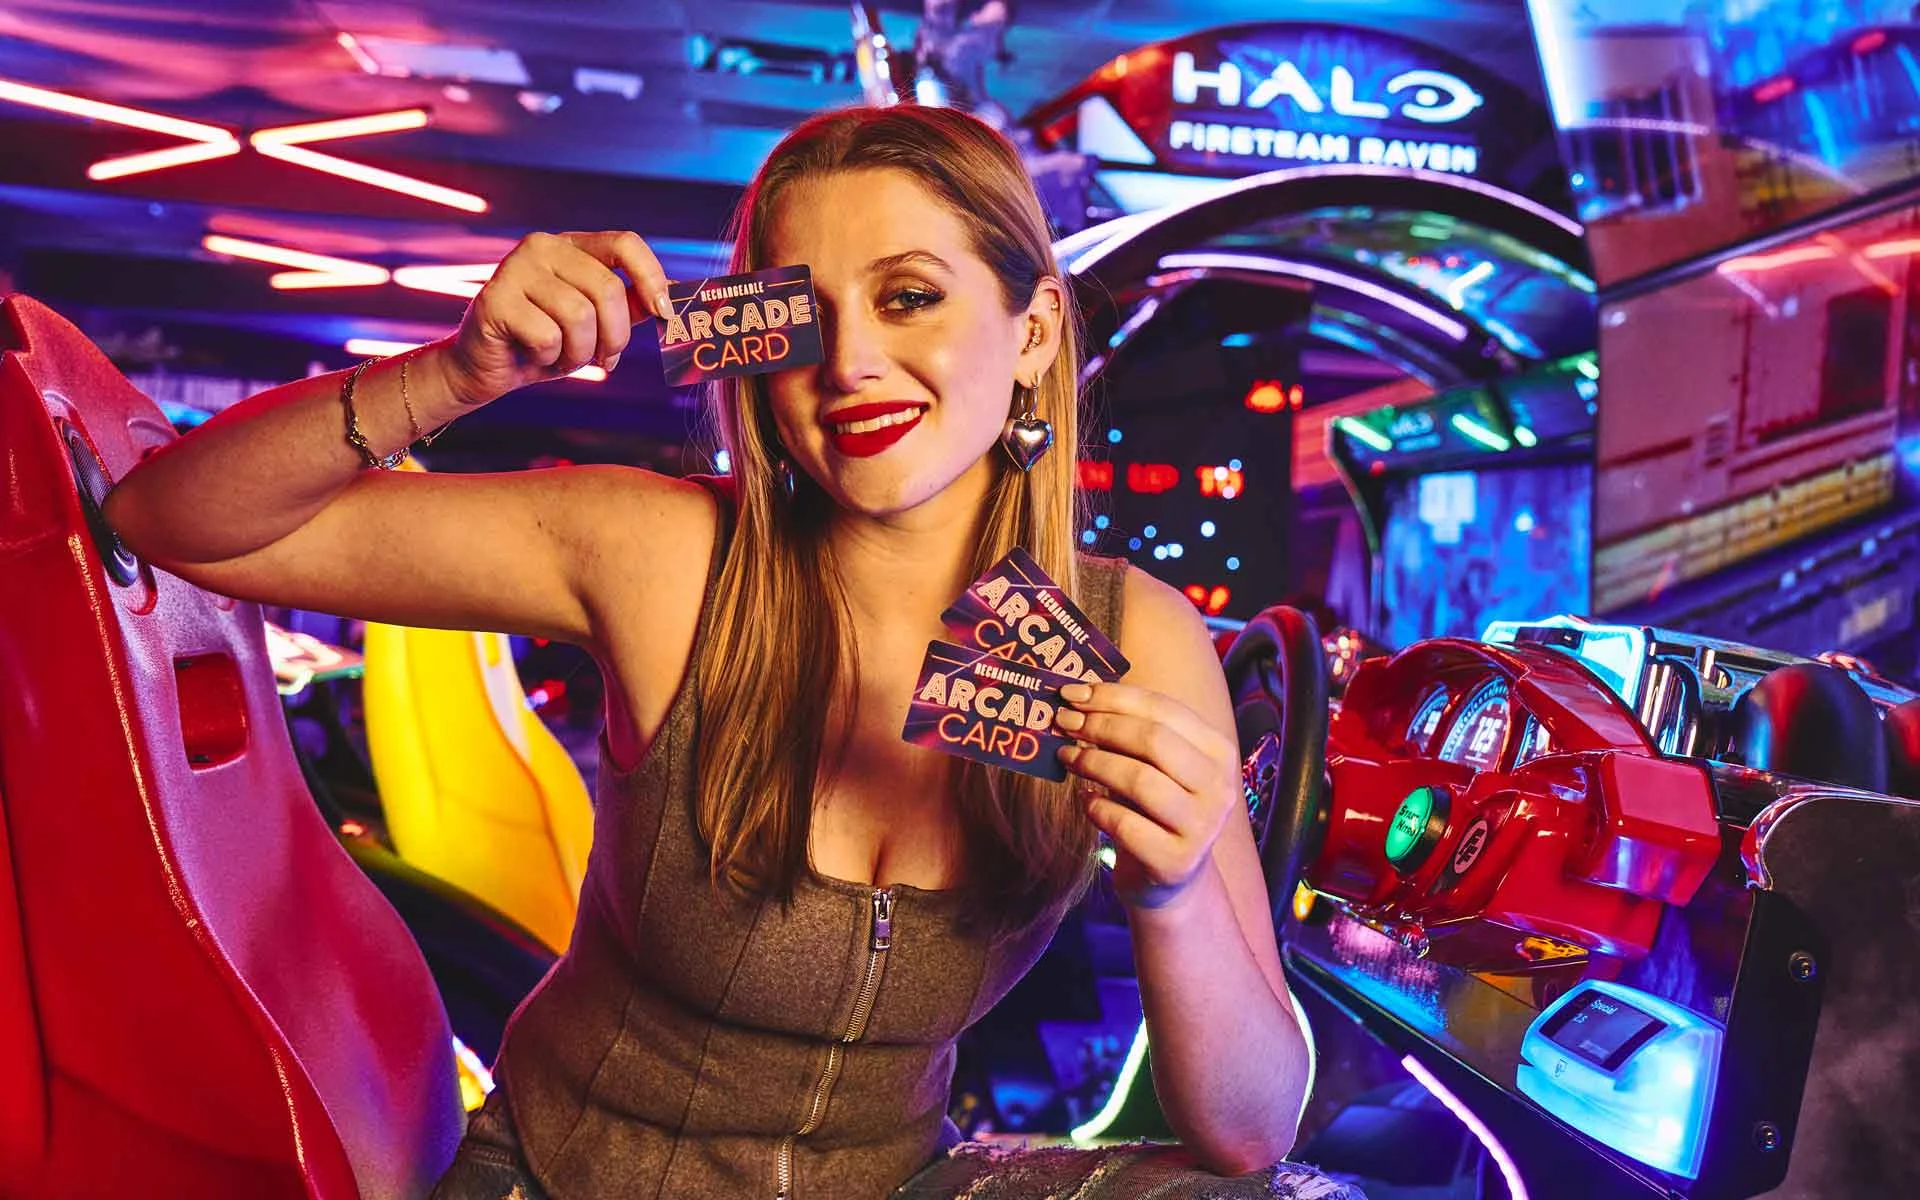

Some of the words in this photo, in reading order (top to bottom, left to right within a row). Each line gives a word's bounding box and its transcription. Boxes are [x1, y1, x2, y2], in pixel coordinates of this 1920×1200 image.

[1172, 51, 1484, 124] HALO
[1169, 121, 1351, 161] FIRETEAM
[1359, 137, 1478, 173] RAVEN
[700, 281, 765, 302] RECHARGEABLE
[666, 294, 812, 344] ARCADE
[693, 333, 790, 371] CARD
[1036, 589, 1089, 645] RECHARGEABLE
[974, 662, 1043, 691] RECHARGEABLE
[920, 672, 1063, 737] ARCAD
[938, 713, 1040, 762] CARD
[1469, 716, 1503, 753] 125
